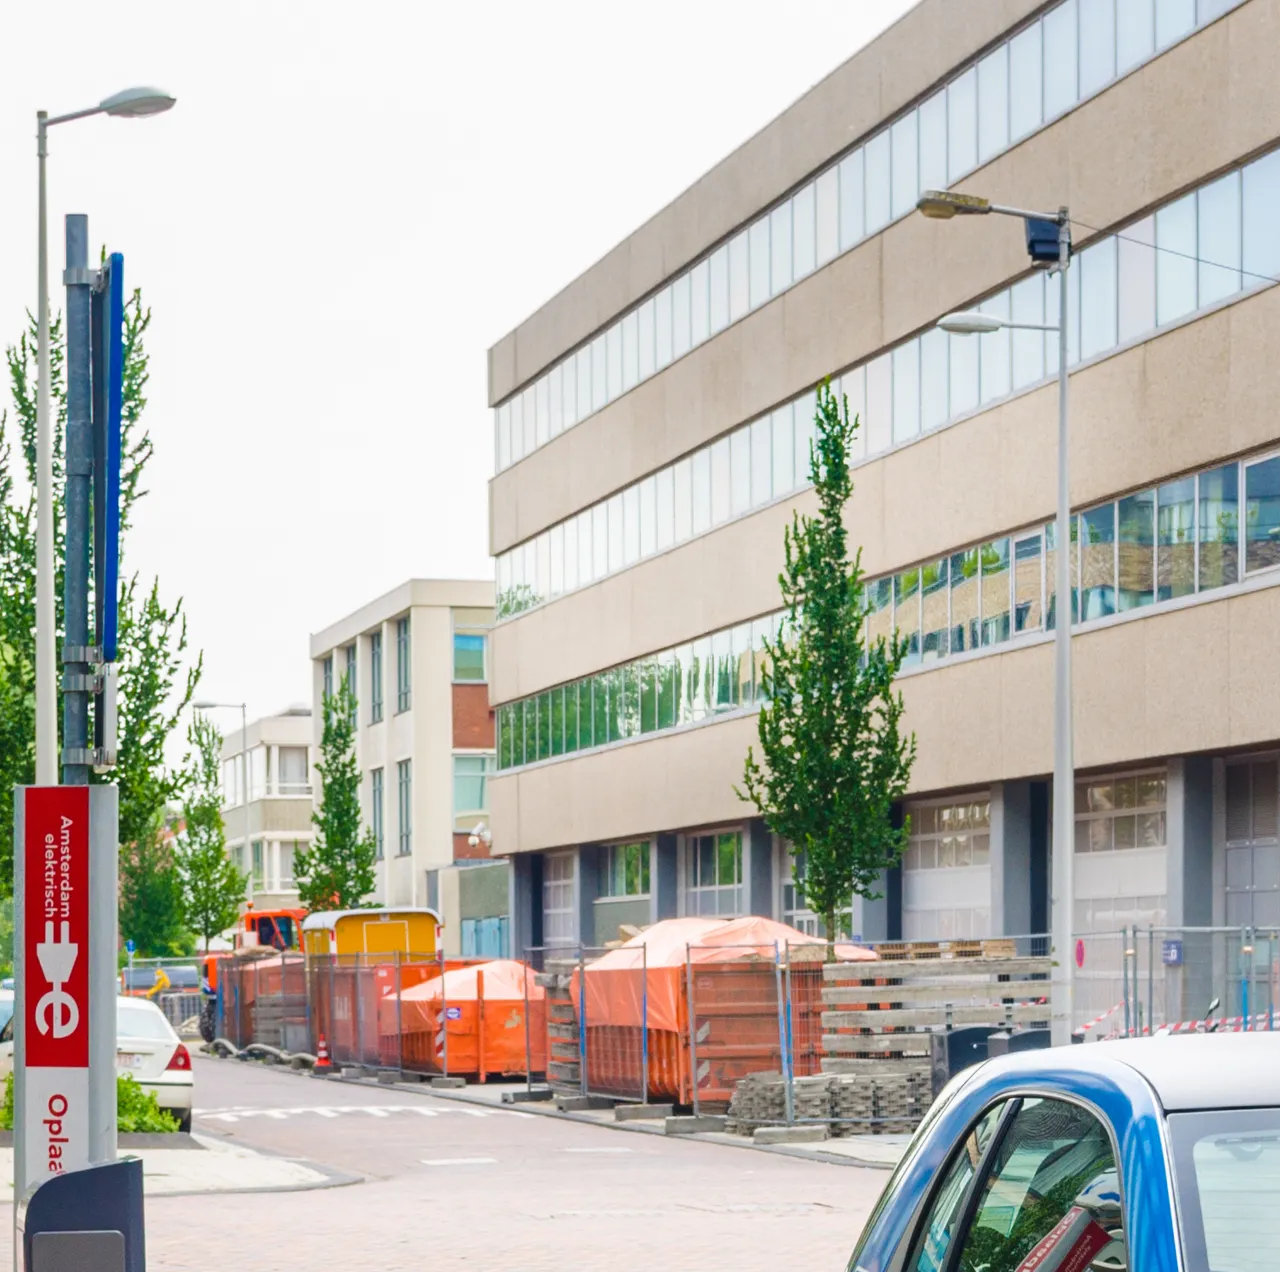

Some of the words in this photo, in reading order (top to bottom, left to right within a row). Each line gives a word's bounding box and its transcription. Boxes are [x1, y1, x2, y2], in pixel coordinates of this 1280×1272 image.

[44, 833, 58, 918] elektrisch
[60, 815, 73, 918] Amsterdam
[43, 1094, 69, 1176] Oplaa
